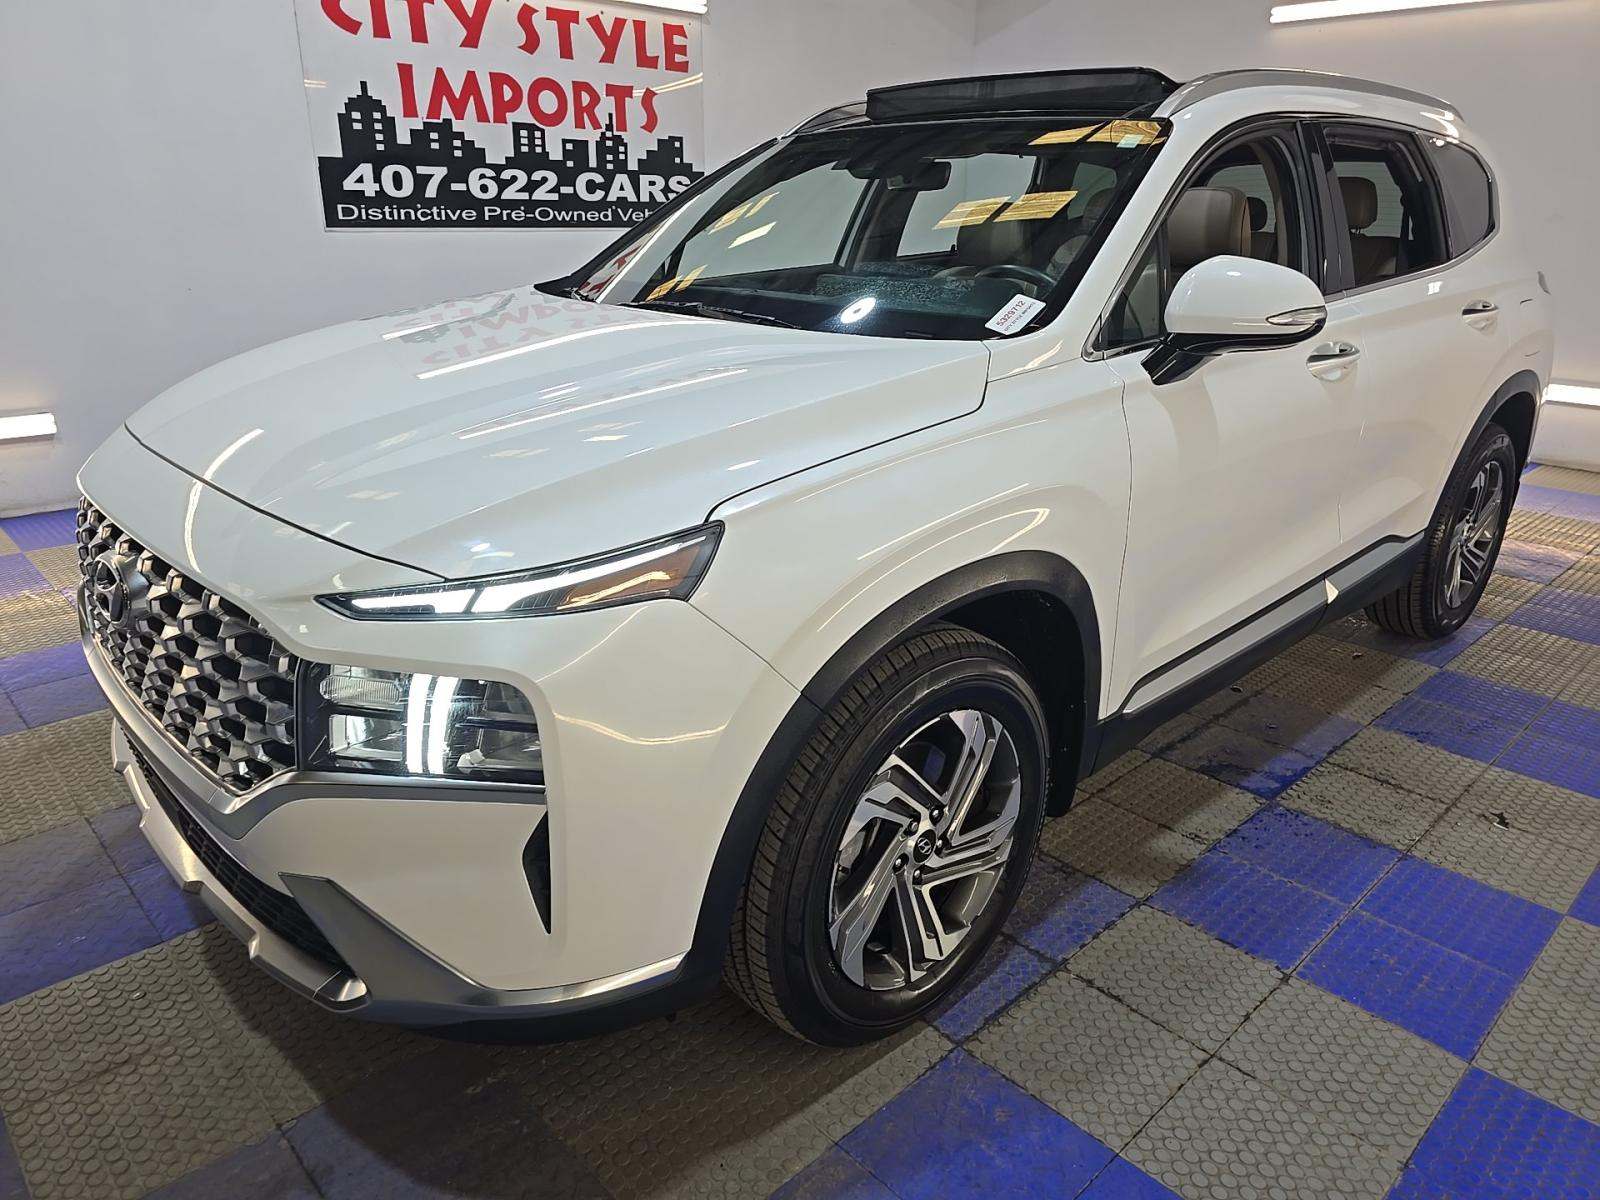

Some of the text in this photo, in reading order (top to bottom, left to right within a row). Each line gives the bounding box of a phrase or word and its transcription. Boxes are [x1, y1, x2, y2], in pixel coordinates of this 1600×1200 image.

[320, 0, 690, 73] CITY STYLE
[396, 62, 659, 134] IMPORTS
[342, 162, 691, 202] 407-622-CARS
[336, 203, 477, 222] Distinctive
[483, 205, 613, 222] Pre-Owned
[996, 300, 1026, 327] 5329712
